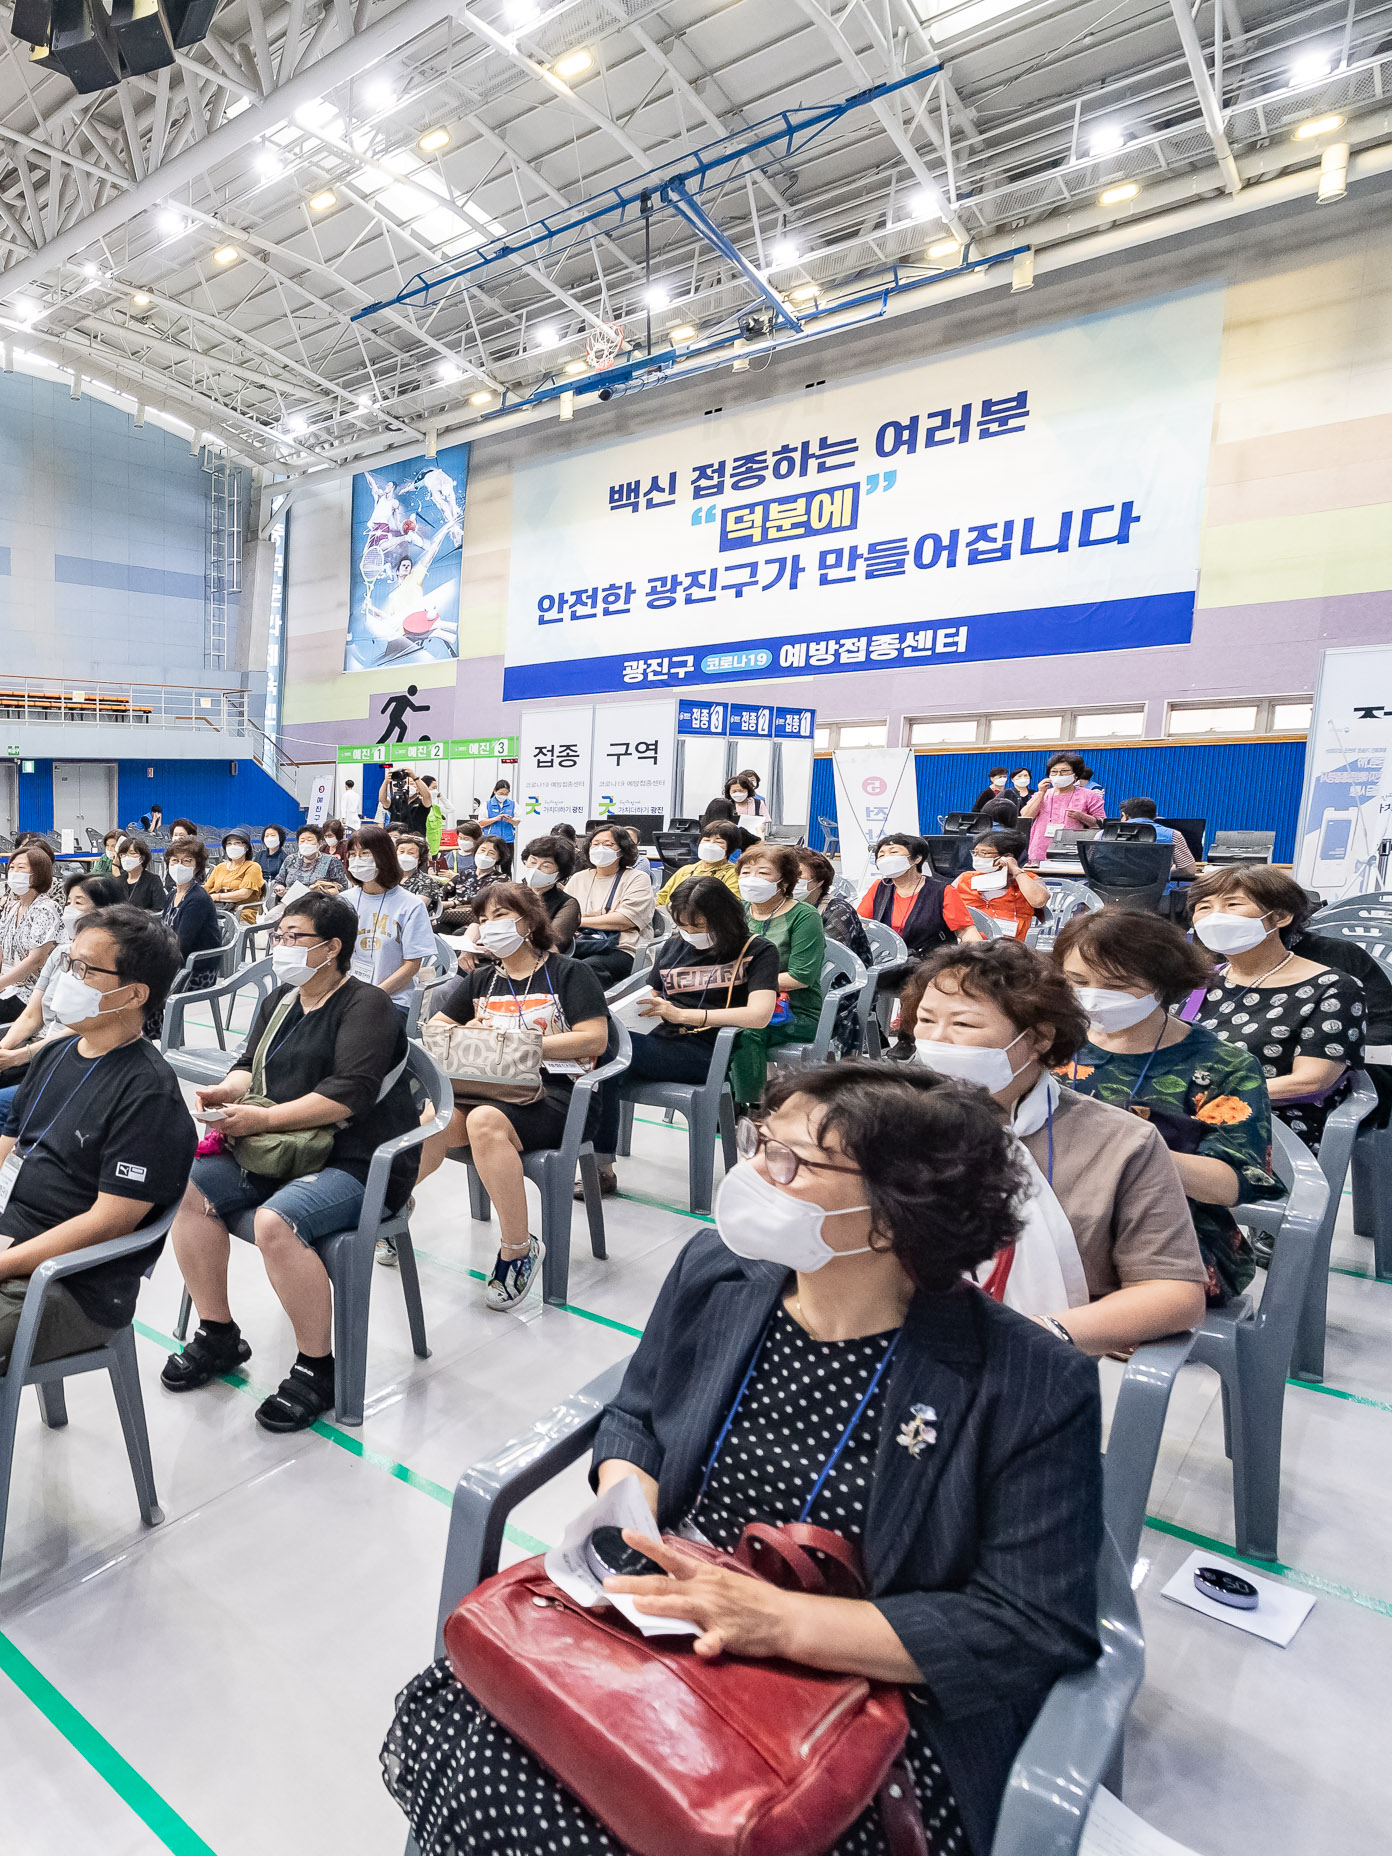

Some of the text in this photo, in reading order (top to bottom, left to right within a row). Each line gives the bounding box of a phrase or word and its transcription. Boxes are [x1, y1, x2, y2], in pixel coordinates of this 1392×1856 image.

[608, 390, 1029, 512] 백신 접종하는 여러분
[538, 501, 1141, 625] 안전한 광진구가 만들어집니다
[621, 626, 968, 683] 광진구 코로나19 예방접종센터
[692, 708, 709, 728] 접종
[741, 711, 757, 731] 접종
[785, 714, 799, 732] 접종
[353, 749, 370, 759] 예진
[408, 745, 440, 757] 예진 2
[469, 743, 489, 754] 예진
[498, 742, 505, 754] 3
[533, 744, 580, 768] 접종
[607, 740, 658, 766] 구역
[650, 806, 664, 814] 광진
